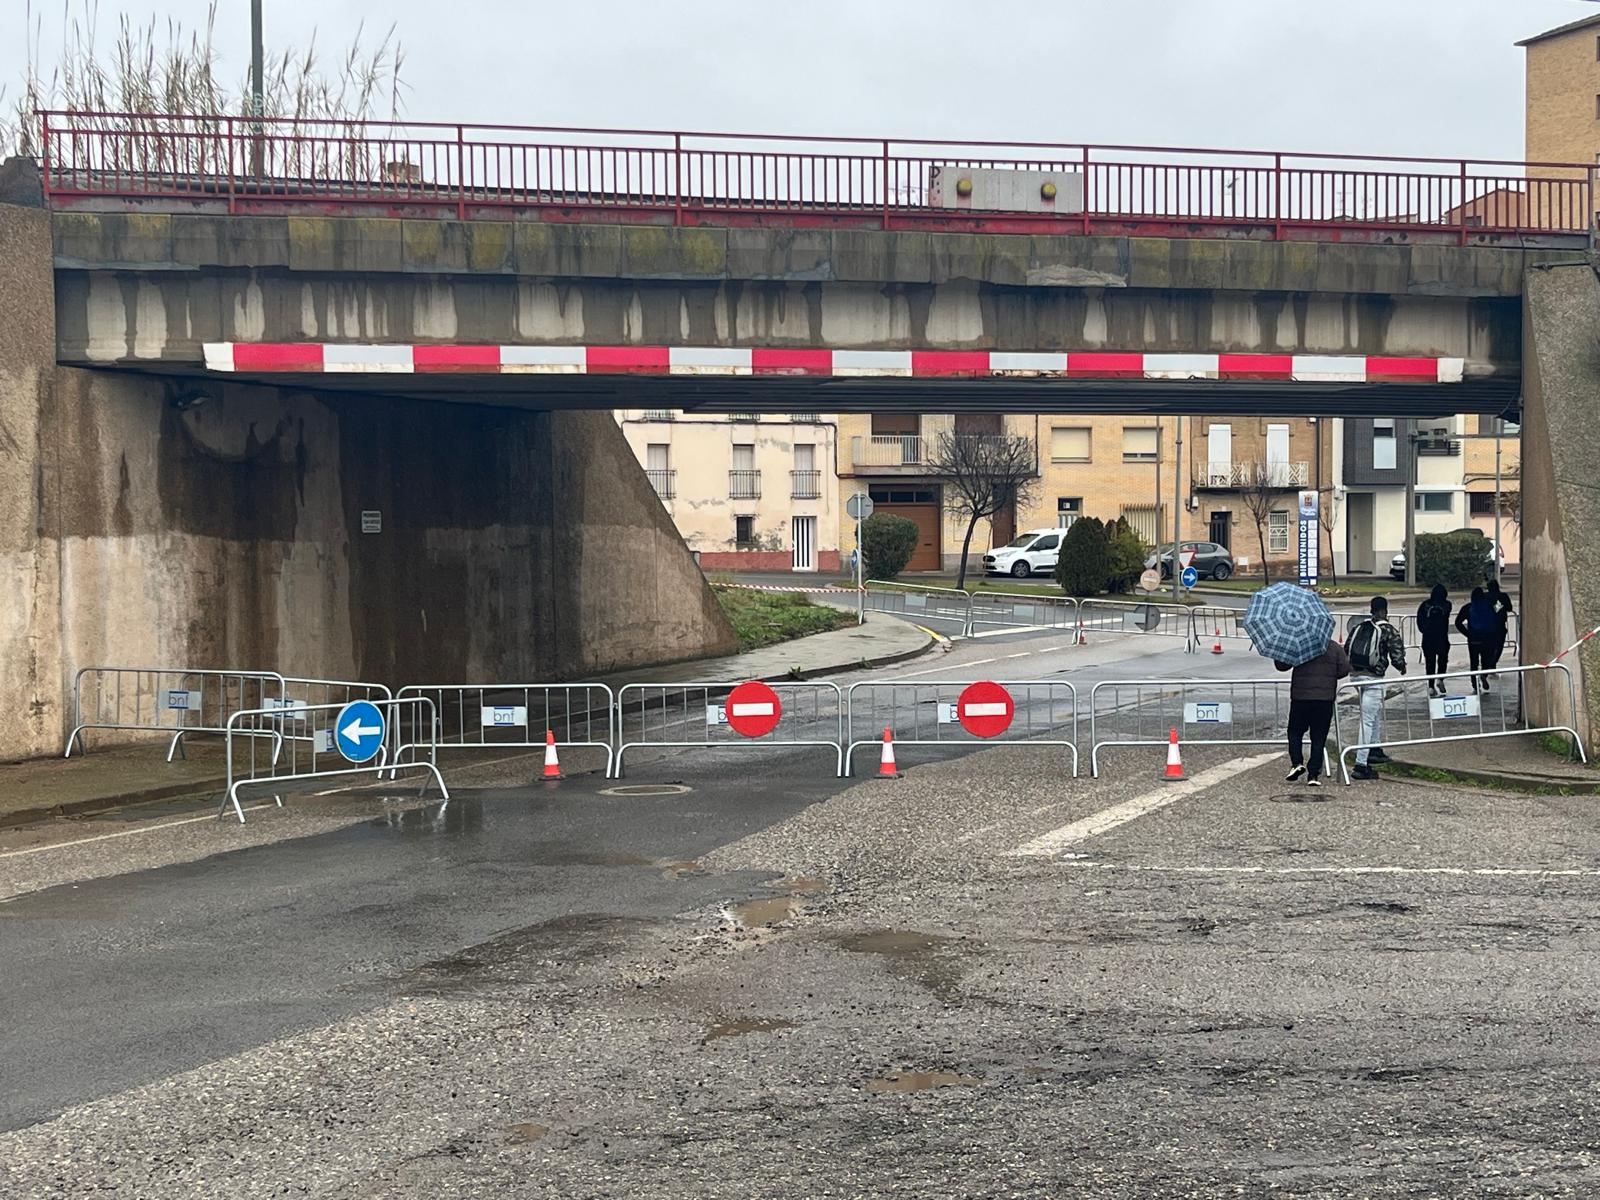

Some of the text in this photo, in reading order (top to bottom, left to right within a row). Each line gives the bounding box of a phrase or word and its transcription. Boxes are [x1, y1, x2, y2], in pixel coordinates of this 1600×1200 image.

[1197, 706, 1219, 719] bnf
[1443, 700, 1467, 714] bnf
[493, 710, 514, 722] bnf
